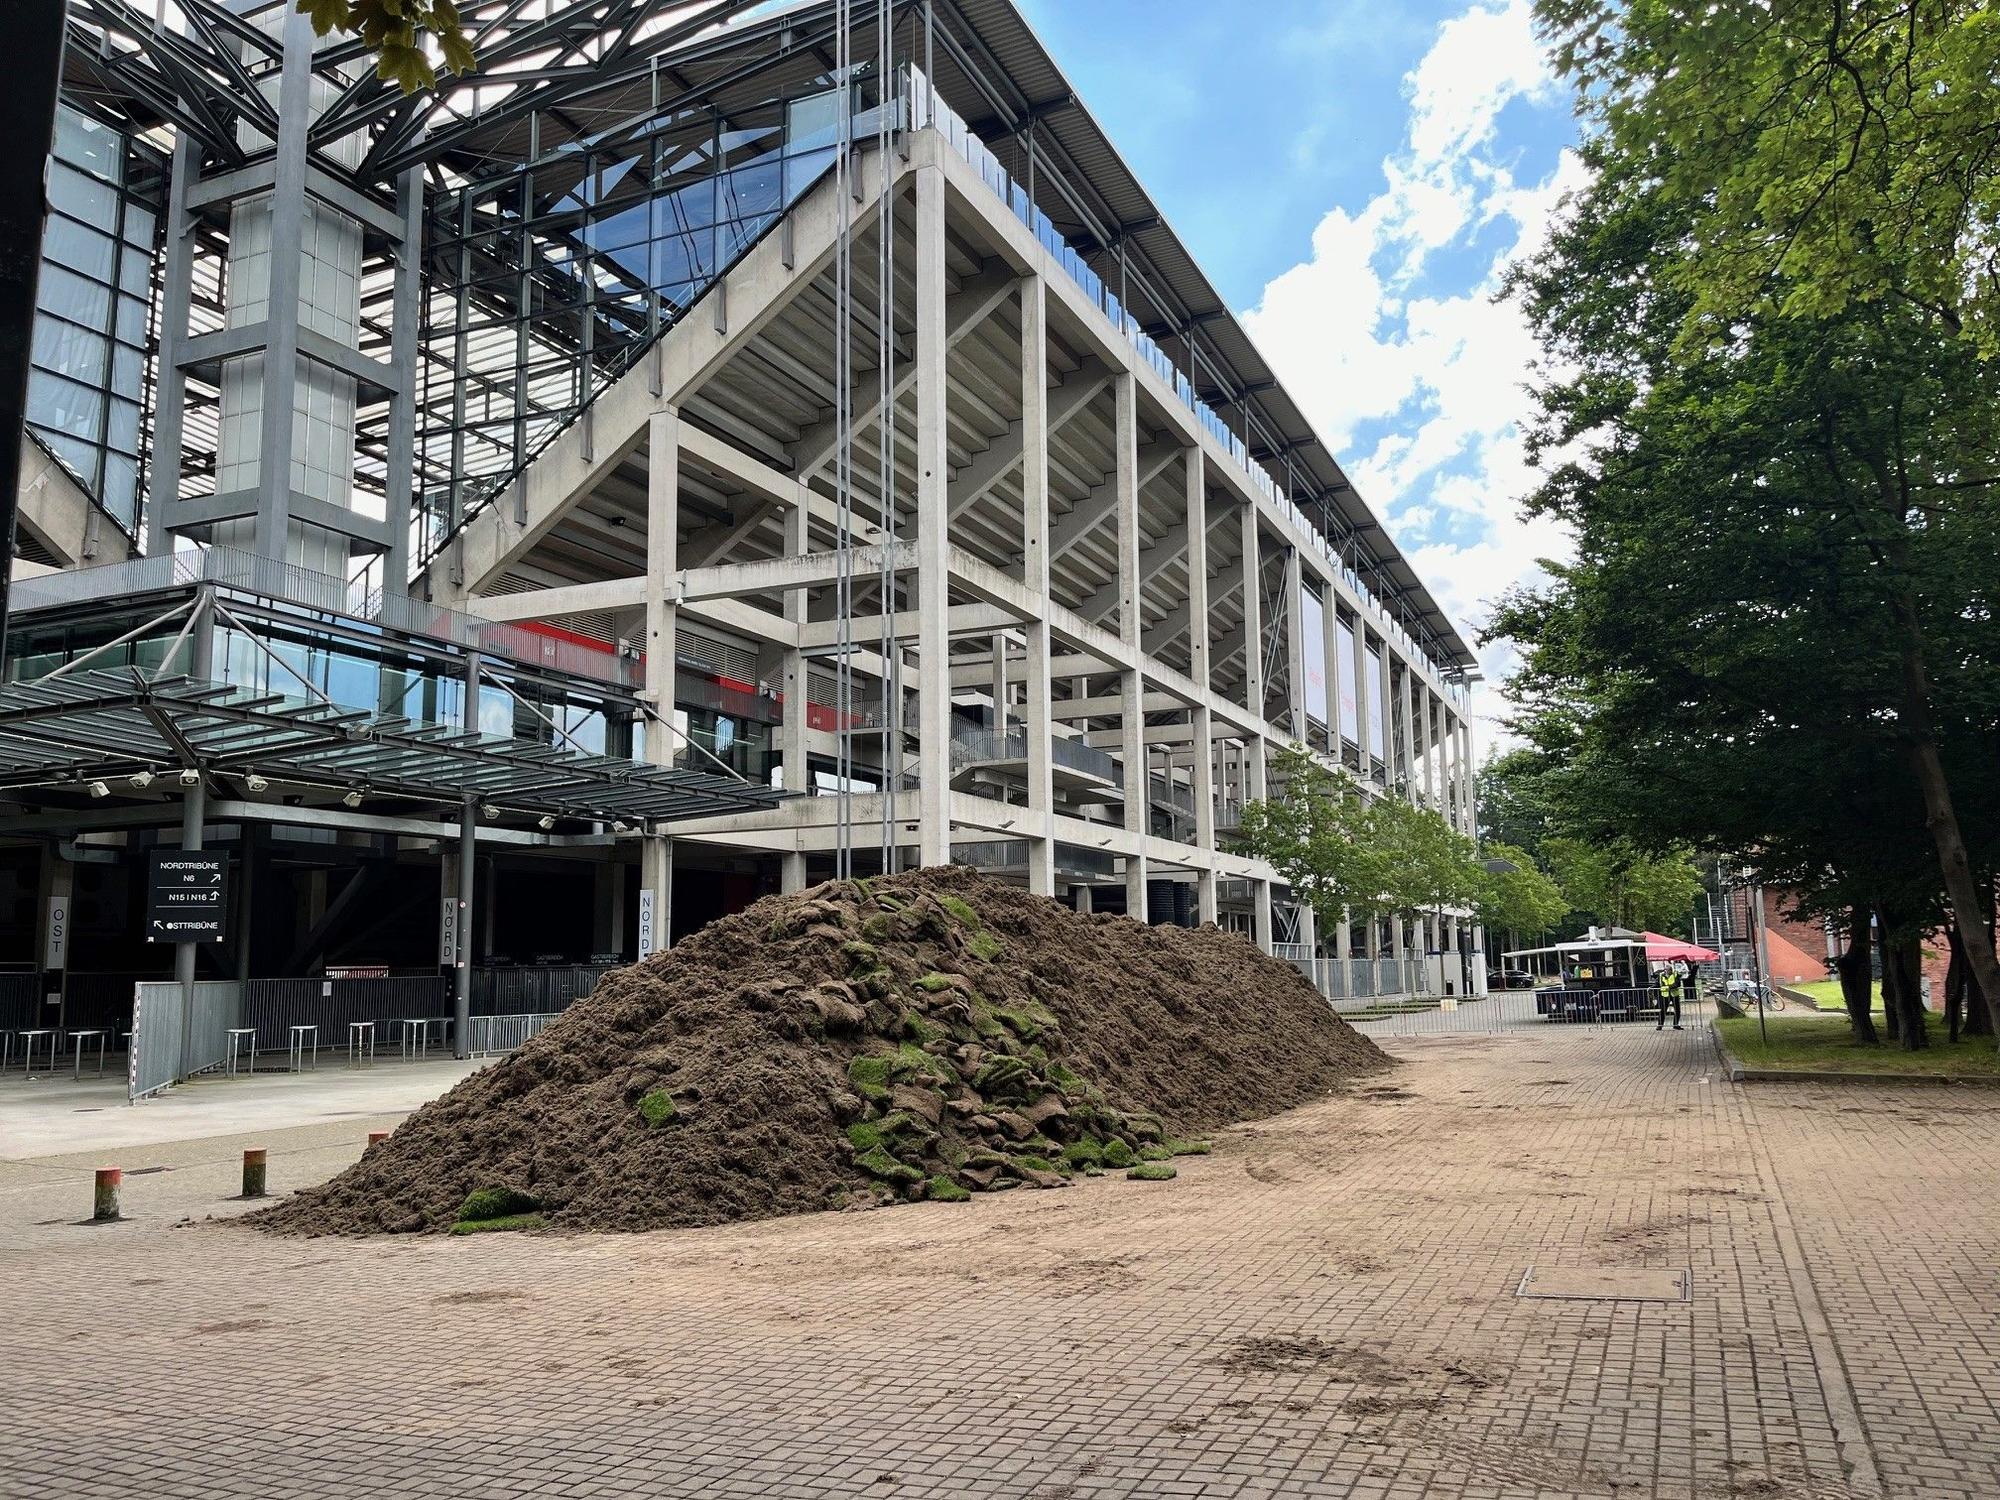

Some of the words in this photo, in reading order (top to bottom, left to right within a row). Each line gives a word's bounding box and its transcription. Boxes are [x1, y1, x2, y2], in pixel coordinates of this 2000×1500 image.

[160, 862, 219, 870] NORDTRIBÜNE
[183, 874, 195, 882] N6
[53, 909, 64, 953] OST
[443, 902, 453, 957] NORD
[643, 897, 651, 949] NORD
